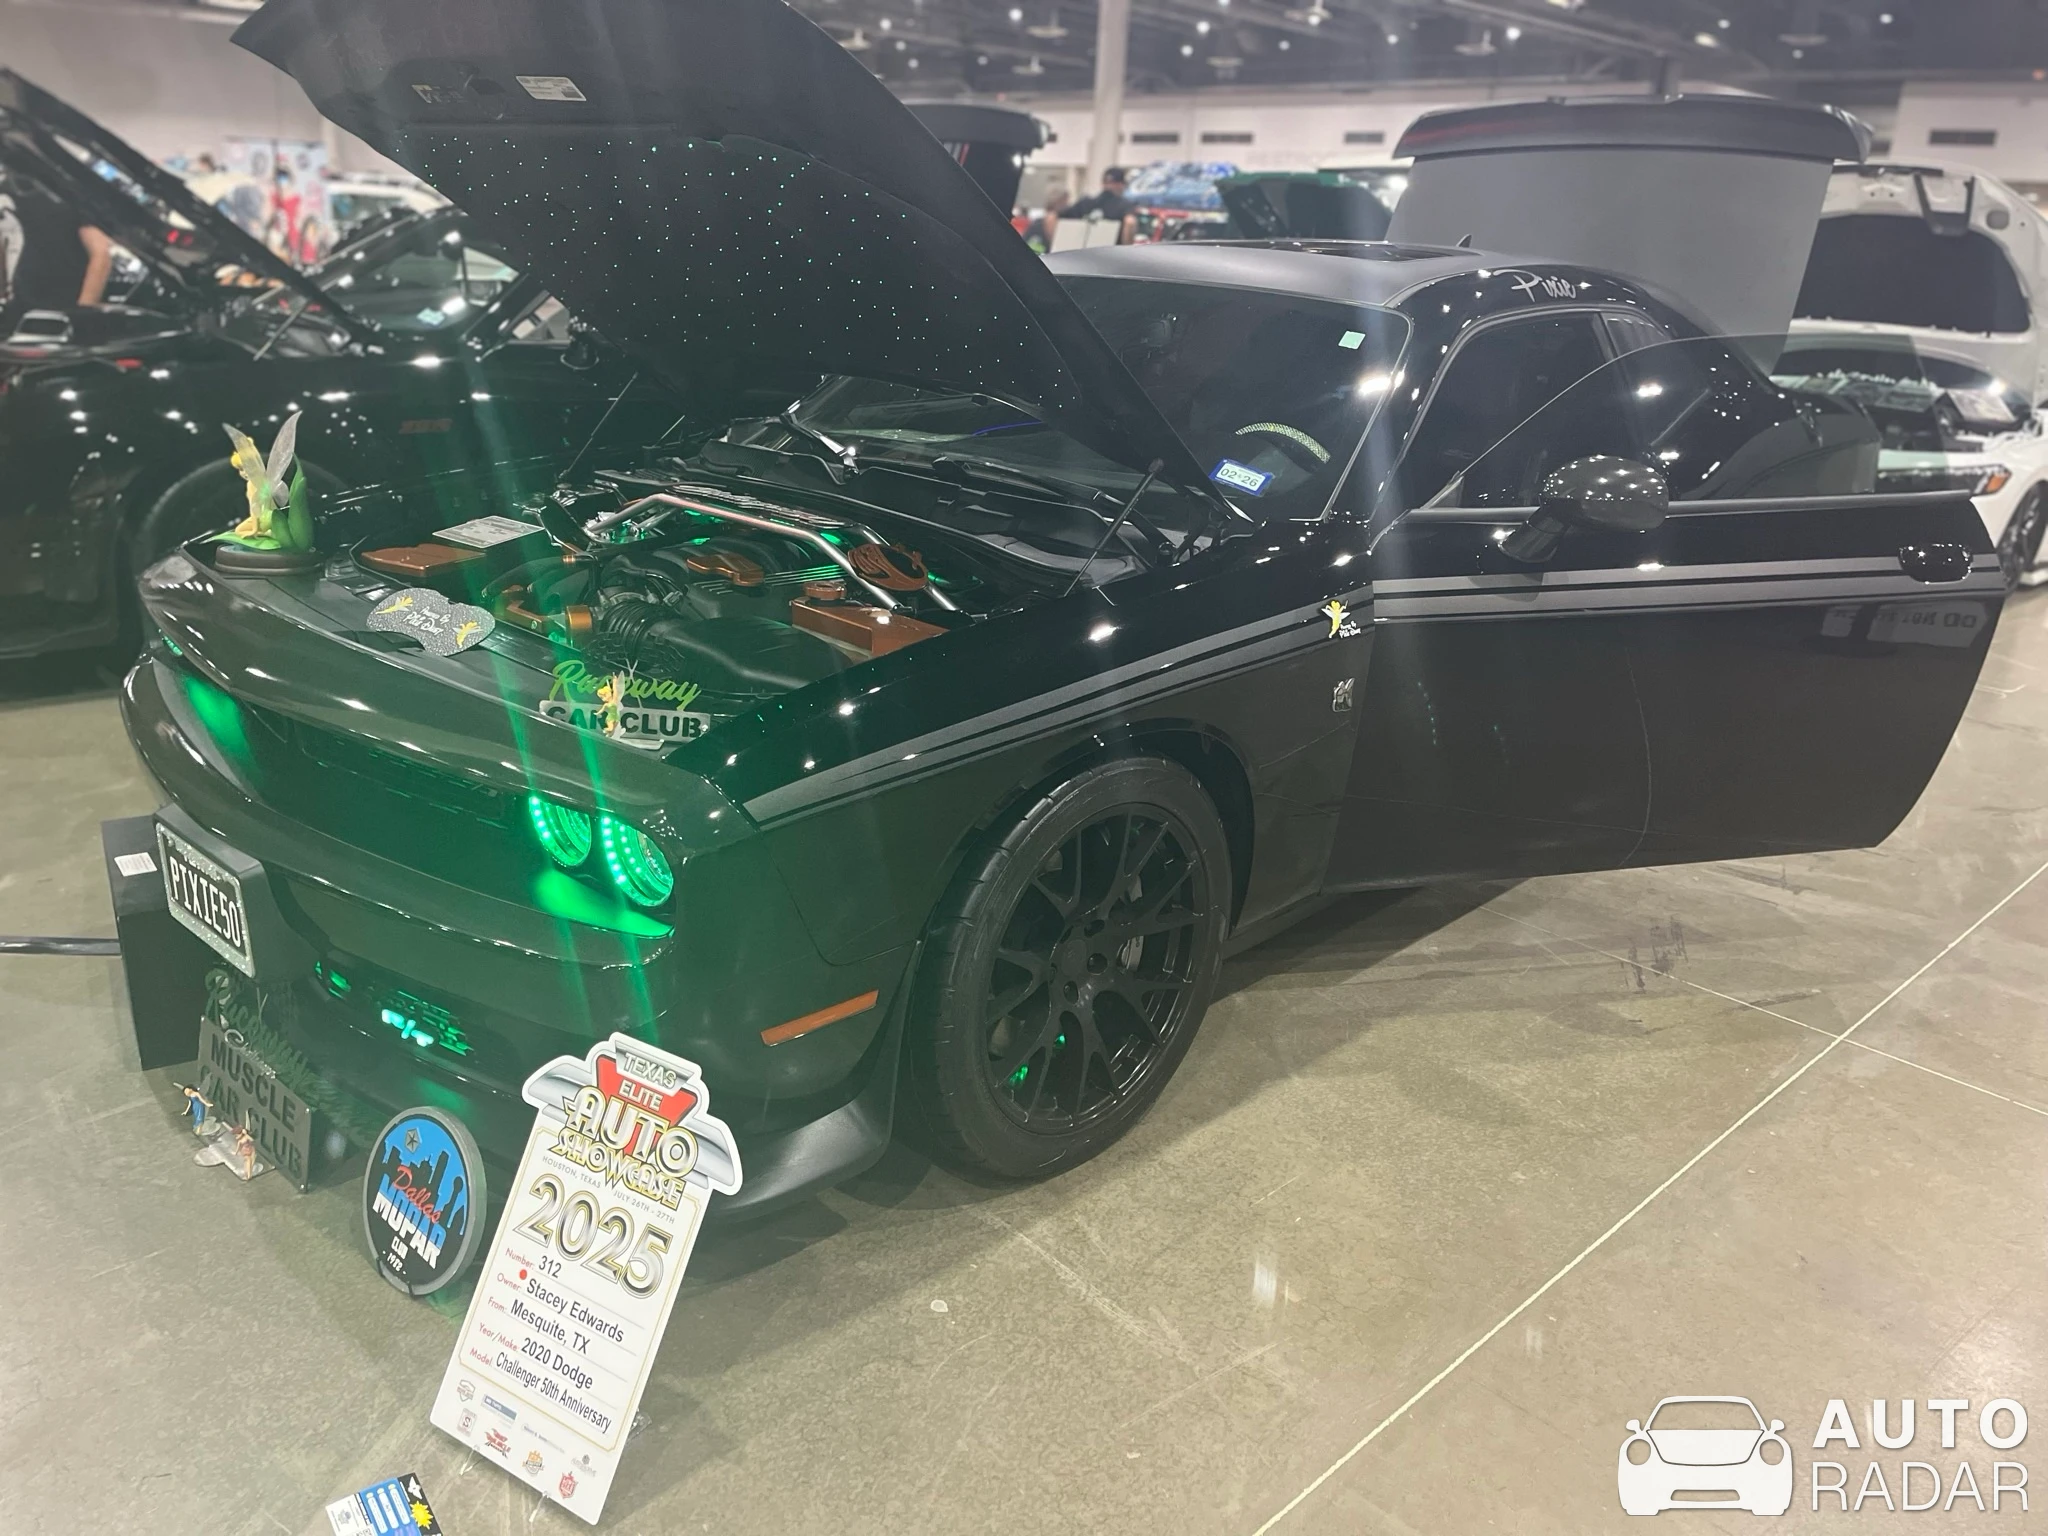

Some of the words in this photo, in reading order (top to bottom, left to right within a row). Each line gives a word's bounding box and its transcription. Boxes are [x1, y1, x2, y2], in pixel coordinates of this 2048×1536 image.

[1493, 269, 1576, 302] Pixie
[620, 712, 702, 738] CLUB
[169, 856, 241, 948] PIXIE50
[211, 1033, 297, 1133] MUSCLE
[618, 1079, 664, 1112] ELITE
[624, 1053, 677, 1089] TEXAS
[562, 1085, 698, 1178] AUTO
[393, 1164, 441, 1224] Dallas
[542, 1155, 578, 1180] HOUSTON,
[580, 1173, 602, 1189] TEXAS
[548, 1127, 687, 1211] SHOWCASE
[372, 1173, 447, 1270] MOPAR
[512, 1173, 674, 1299] 2025
[613, 1189, 630, 1203] JULY
[631, 1198, 650, 1213] 26TH
[656, 1209, 676, 1225] 27TH
[505, 1247, 534, 1270] Number:
[538, 1255, 562, 1279] 312
[487, 1296, 507, 1313] From:
[510, 1299, 567, 1346] Mesquite,
[572, 1331, 592, 1355] TX
[497, 1273, 522, 1292] Owner:
[526, 1278, 568, 1314] Stacey
[570, 1301, 624, 1343] Edwards
[479, 1322, 520, 1353] Year/Make:
[521, 1337, 551, 1365] 2020
[552, 1354, 593, 1390] Dodge
[496, 1351, 542, 1388] Challenger
[540, 1377, 560, 1400] 50th
[559, 1388, 612, 1434] Anniversary
